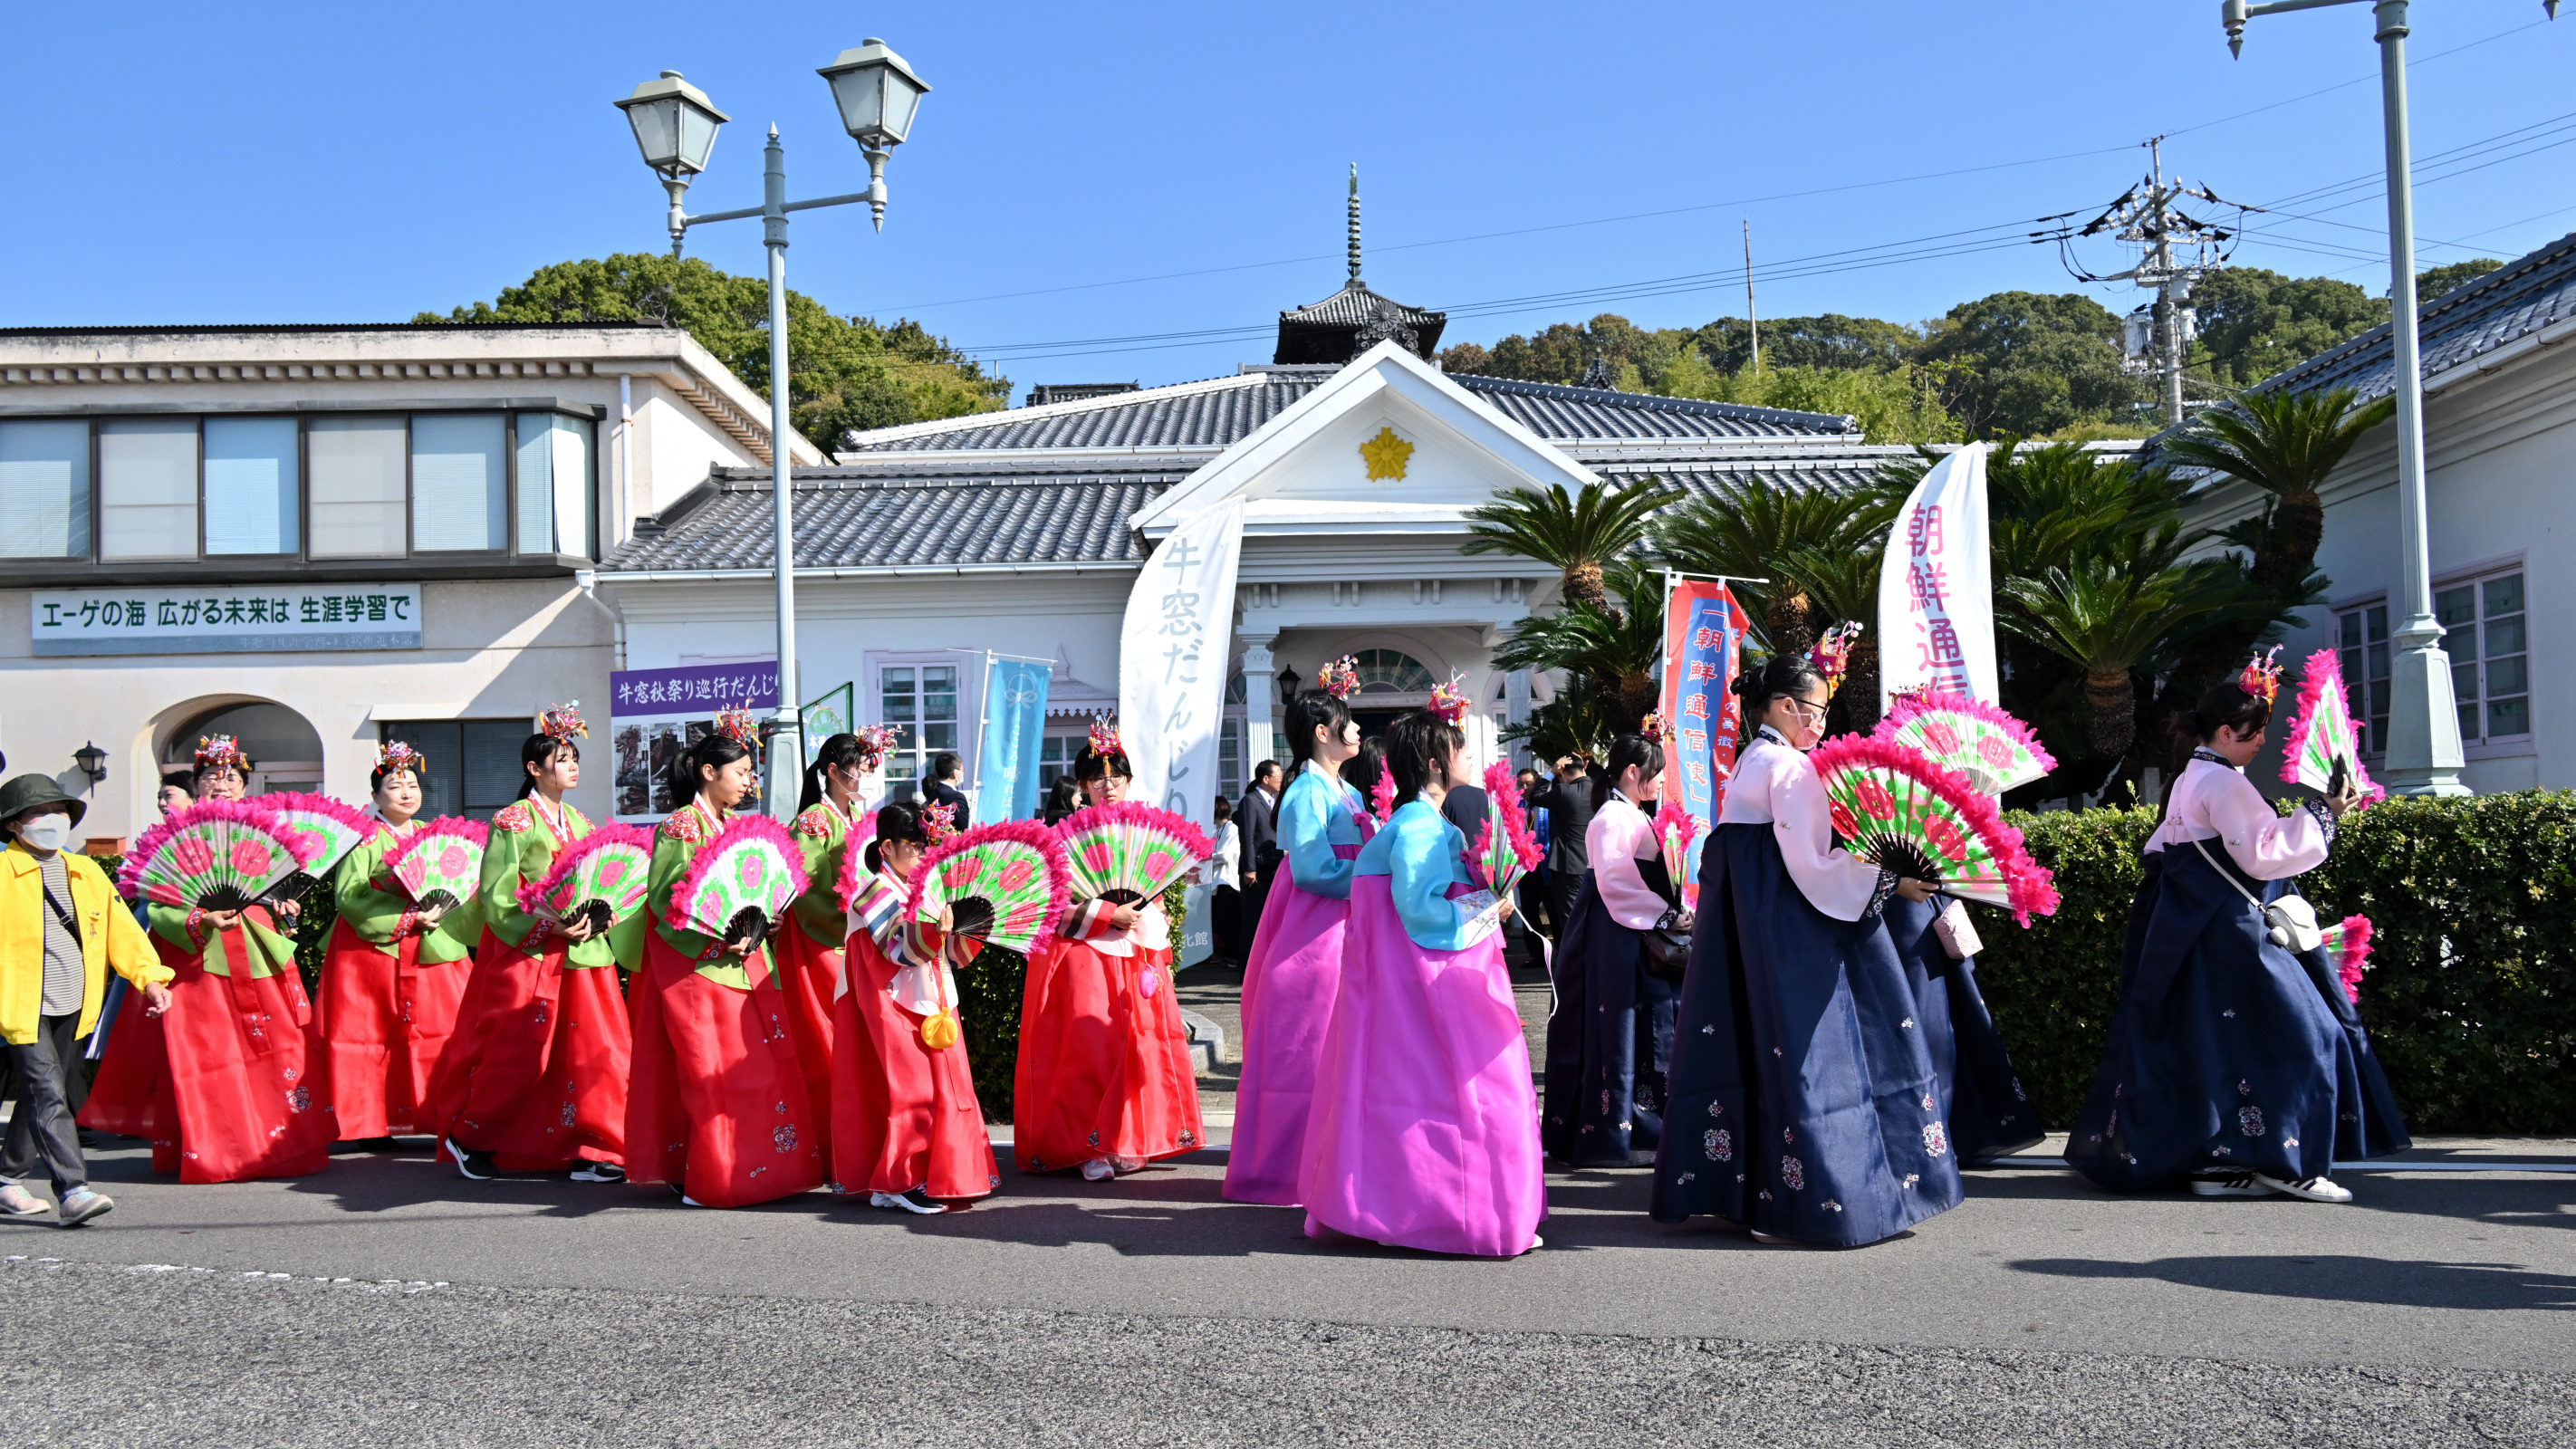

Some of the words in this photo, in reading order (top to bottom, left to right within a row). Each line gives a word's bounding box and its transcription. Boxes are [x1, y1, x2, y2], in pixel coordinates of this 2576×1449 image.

[42, 599, 147, 628] エーゲの海
[157, 597, 291, 627] 広がる未来は
[300, 594, 411, 623] 生涯学習で
[1158, 537, 1204, 821] 牛窓だんじり
[1000, 724, 1021, 820] こころ晴ればれ
[1683, 609, 1728, 869] 「朝鮮通信使」行
